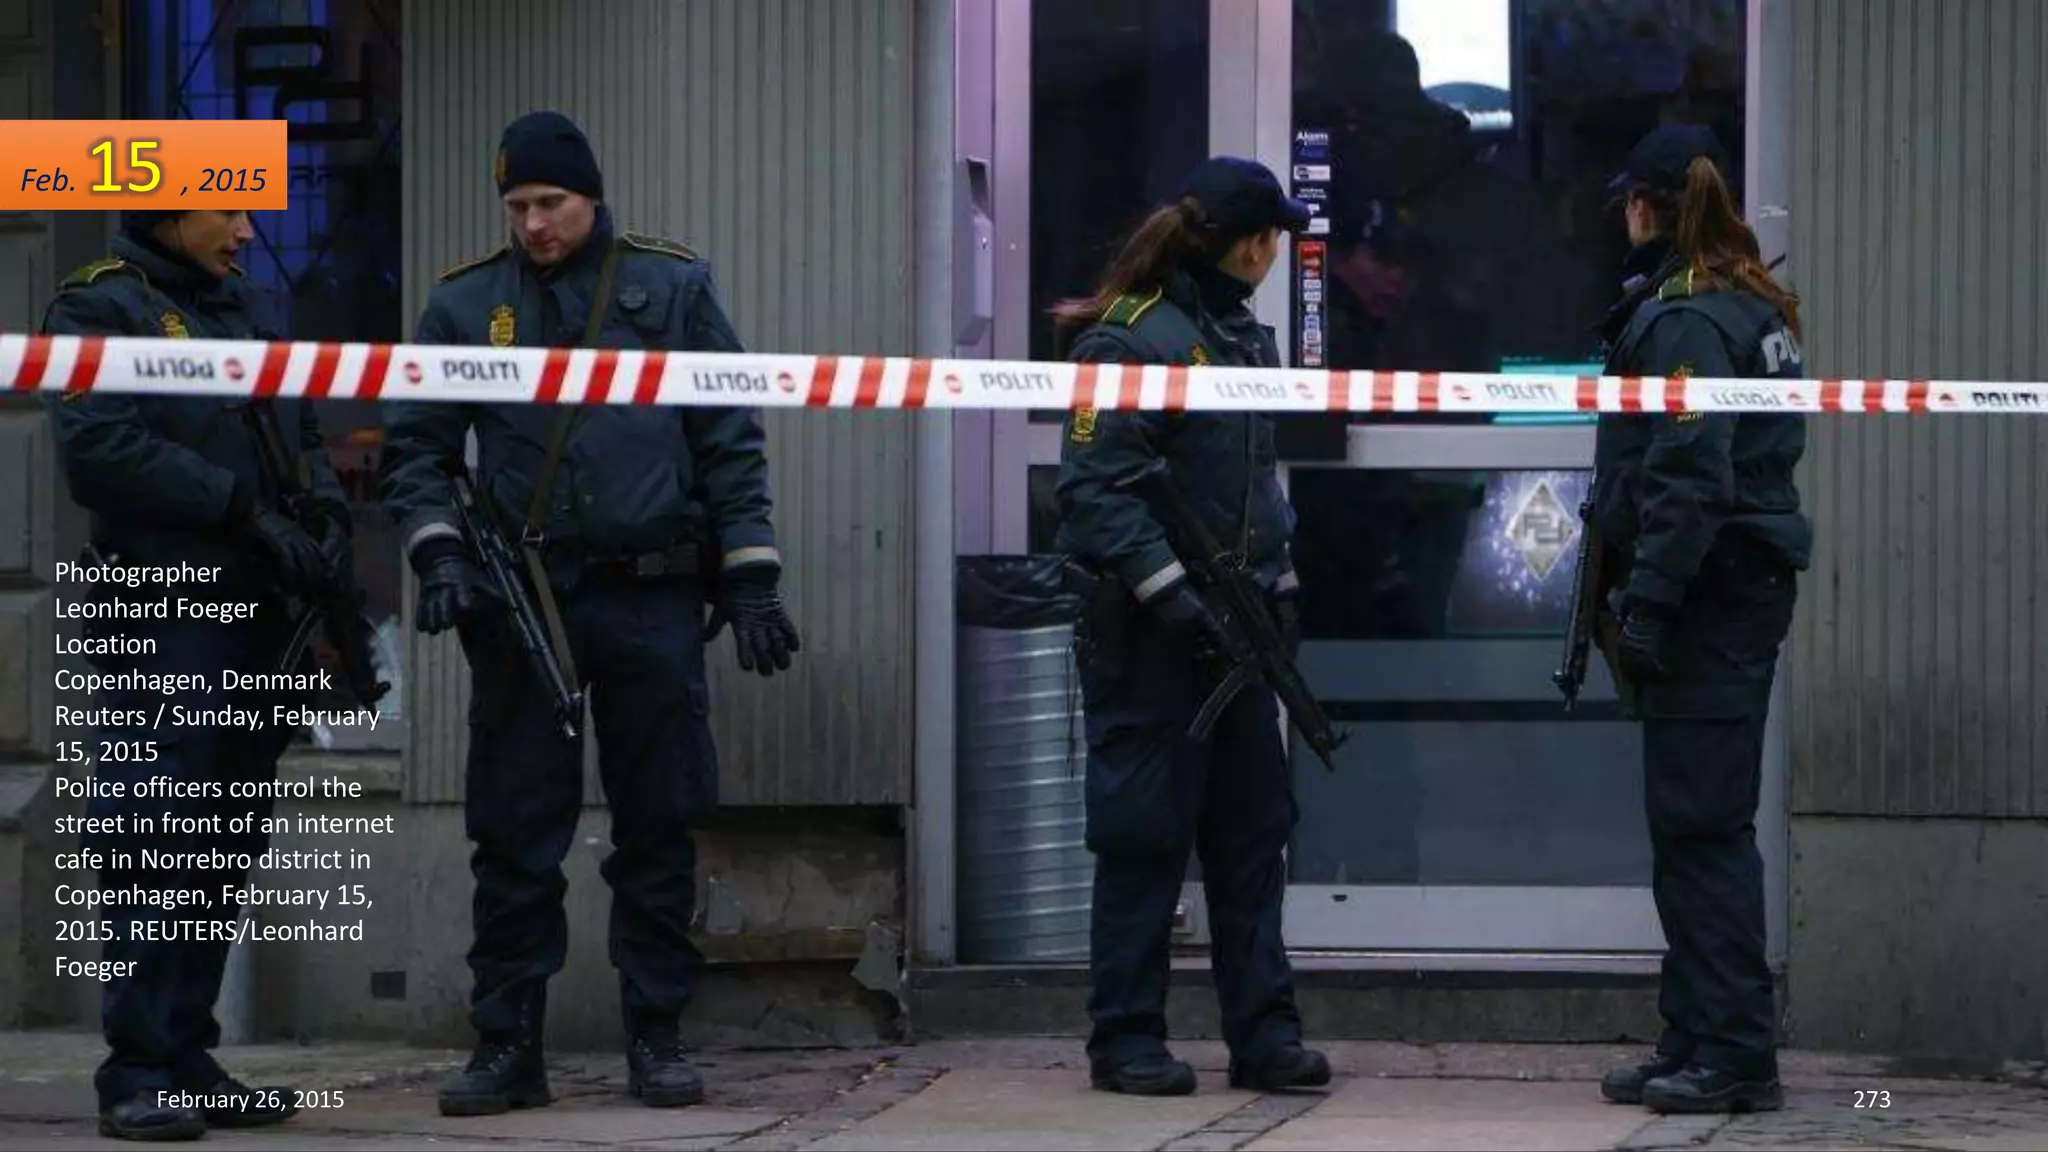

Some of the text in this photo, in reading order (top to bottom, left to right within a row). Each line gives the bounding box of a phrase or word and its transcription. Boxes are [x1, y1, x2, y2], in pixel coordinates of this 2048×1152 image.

[133, 356, 215, 379] POLITI
[441, 359, 520, 381] POLITI
[692, 372, 769, 392] POLITI
[980, 372, 1054, 390] POLITI
